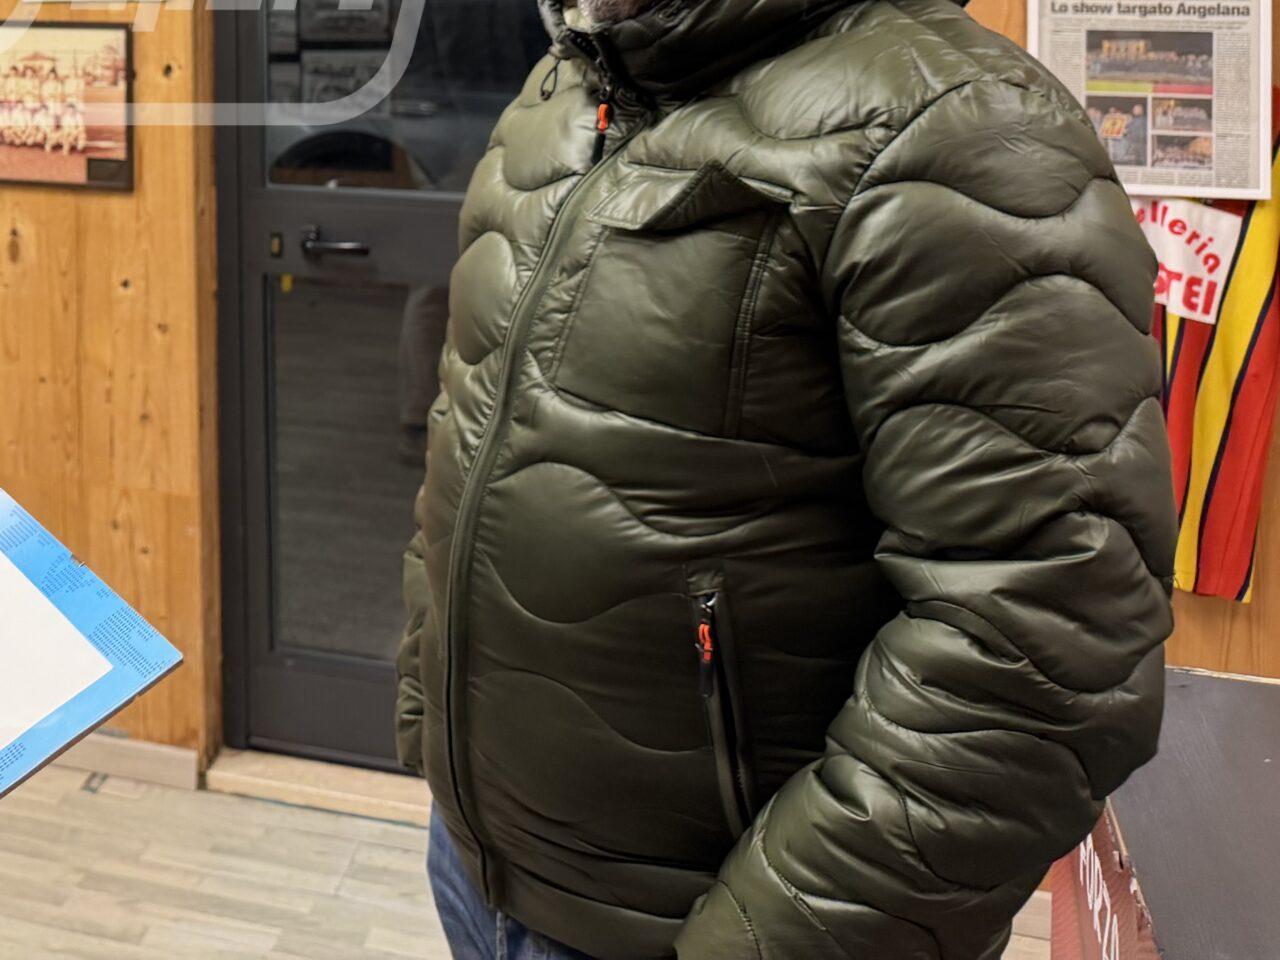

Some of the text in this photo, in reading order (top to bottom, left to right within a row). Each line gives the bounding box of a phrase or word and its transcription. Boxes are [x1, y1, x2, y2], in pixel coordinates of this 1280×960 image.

[1050, 1, 1251, 18] Lo show targato Angelana
